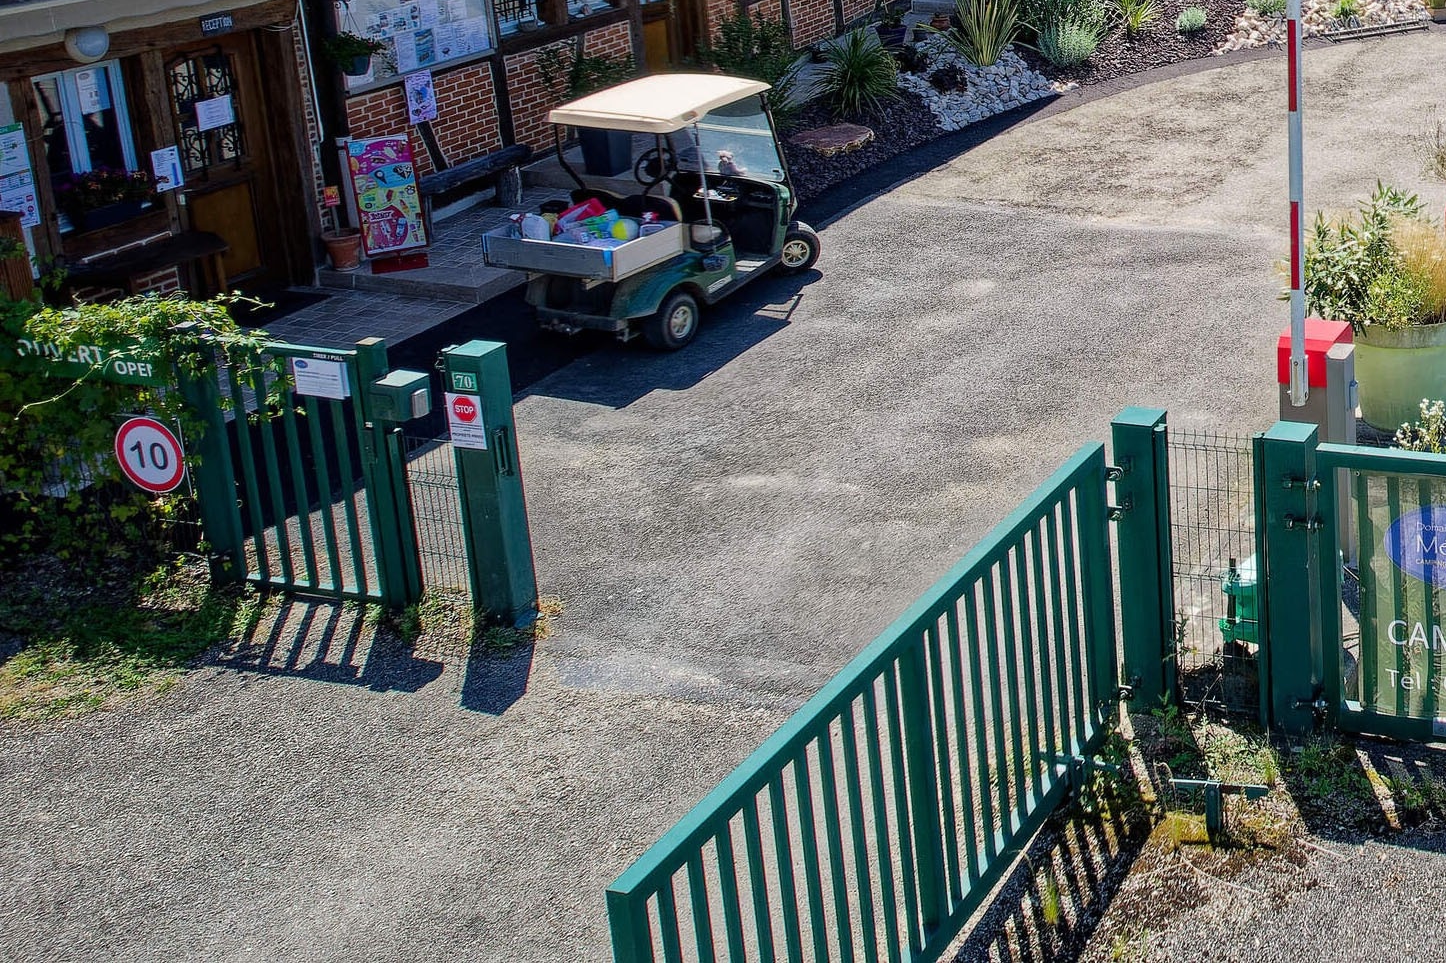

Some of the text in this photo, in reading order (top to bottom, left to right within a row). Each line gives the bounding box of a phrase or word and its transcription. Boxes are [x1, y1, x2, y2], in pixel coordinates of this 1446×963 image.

[455, 374, 473, 389] 70
[454, 404, 474, 415] STOP
[130, 440, 169, 471] 10
[1385, 668, 1421, 691] Tel
